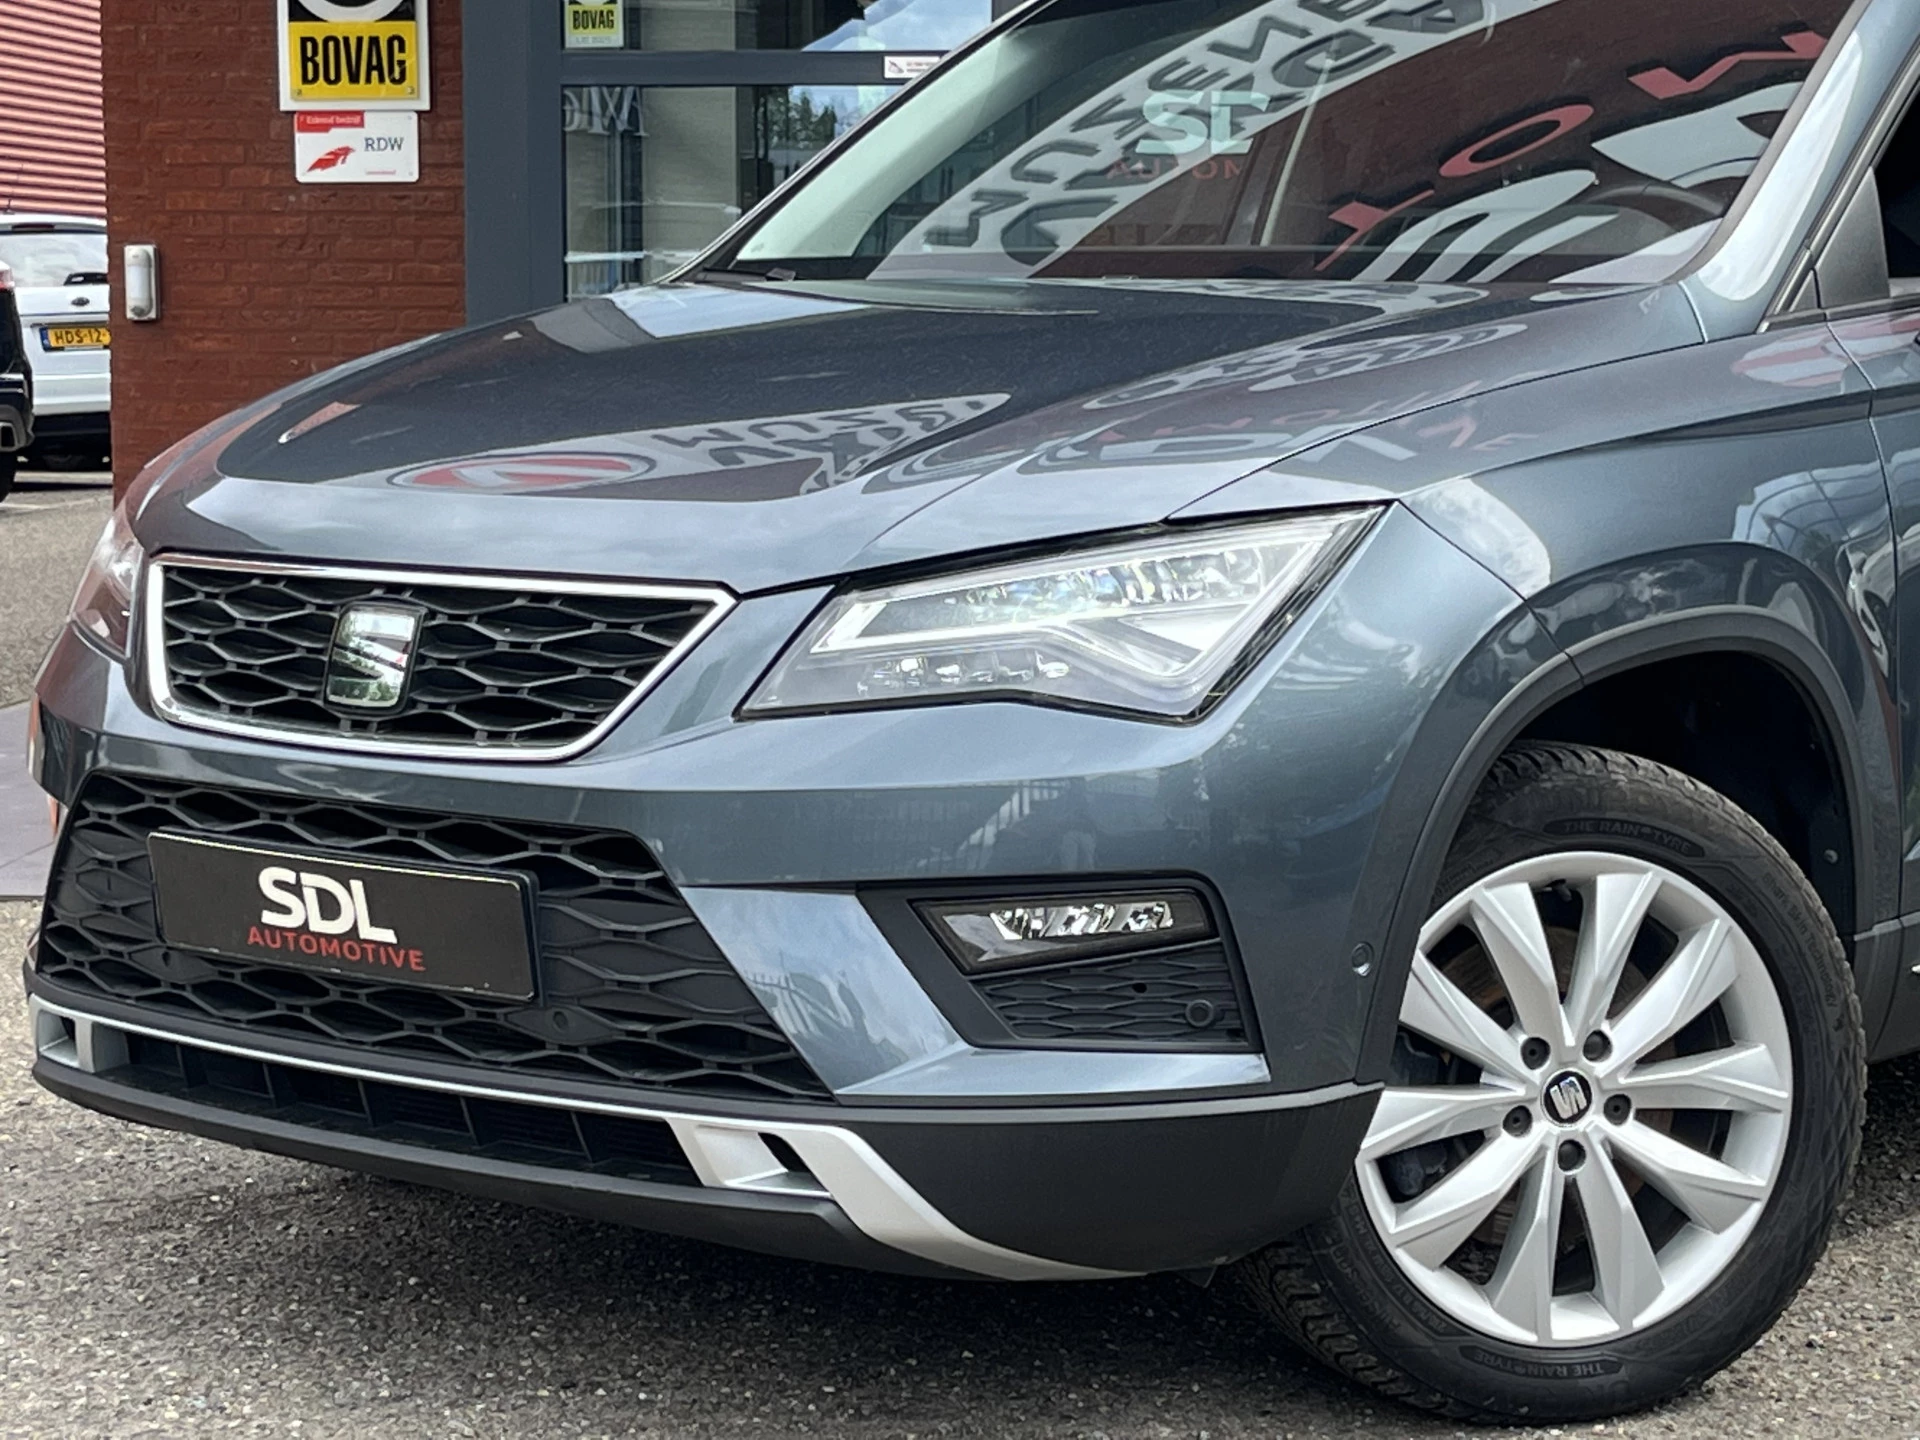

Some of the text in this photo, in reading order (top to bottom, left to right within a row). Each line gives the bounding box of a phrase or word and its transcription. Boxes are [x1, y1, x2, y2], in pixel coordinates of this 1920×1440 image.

[572, 10, 615, 30] BOVAG
[299, 34, 408, 86] BOVAG
[364, 136, 405, 152] RDW
[1598, 820, 1640, 836] RAIN
[1652, 831, 1692, 853] TYRE
[258, 865, 398, 945] SDL
[247, 925, 427, 972] AUTOMOTIVE
